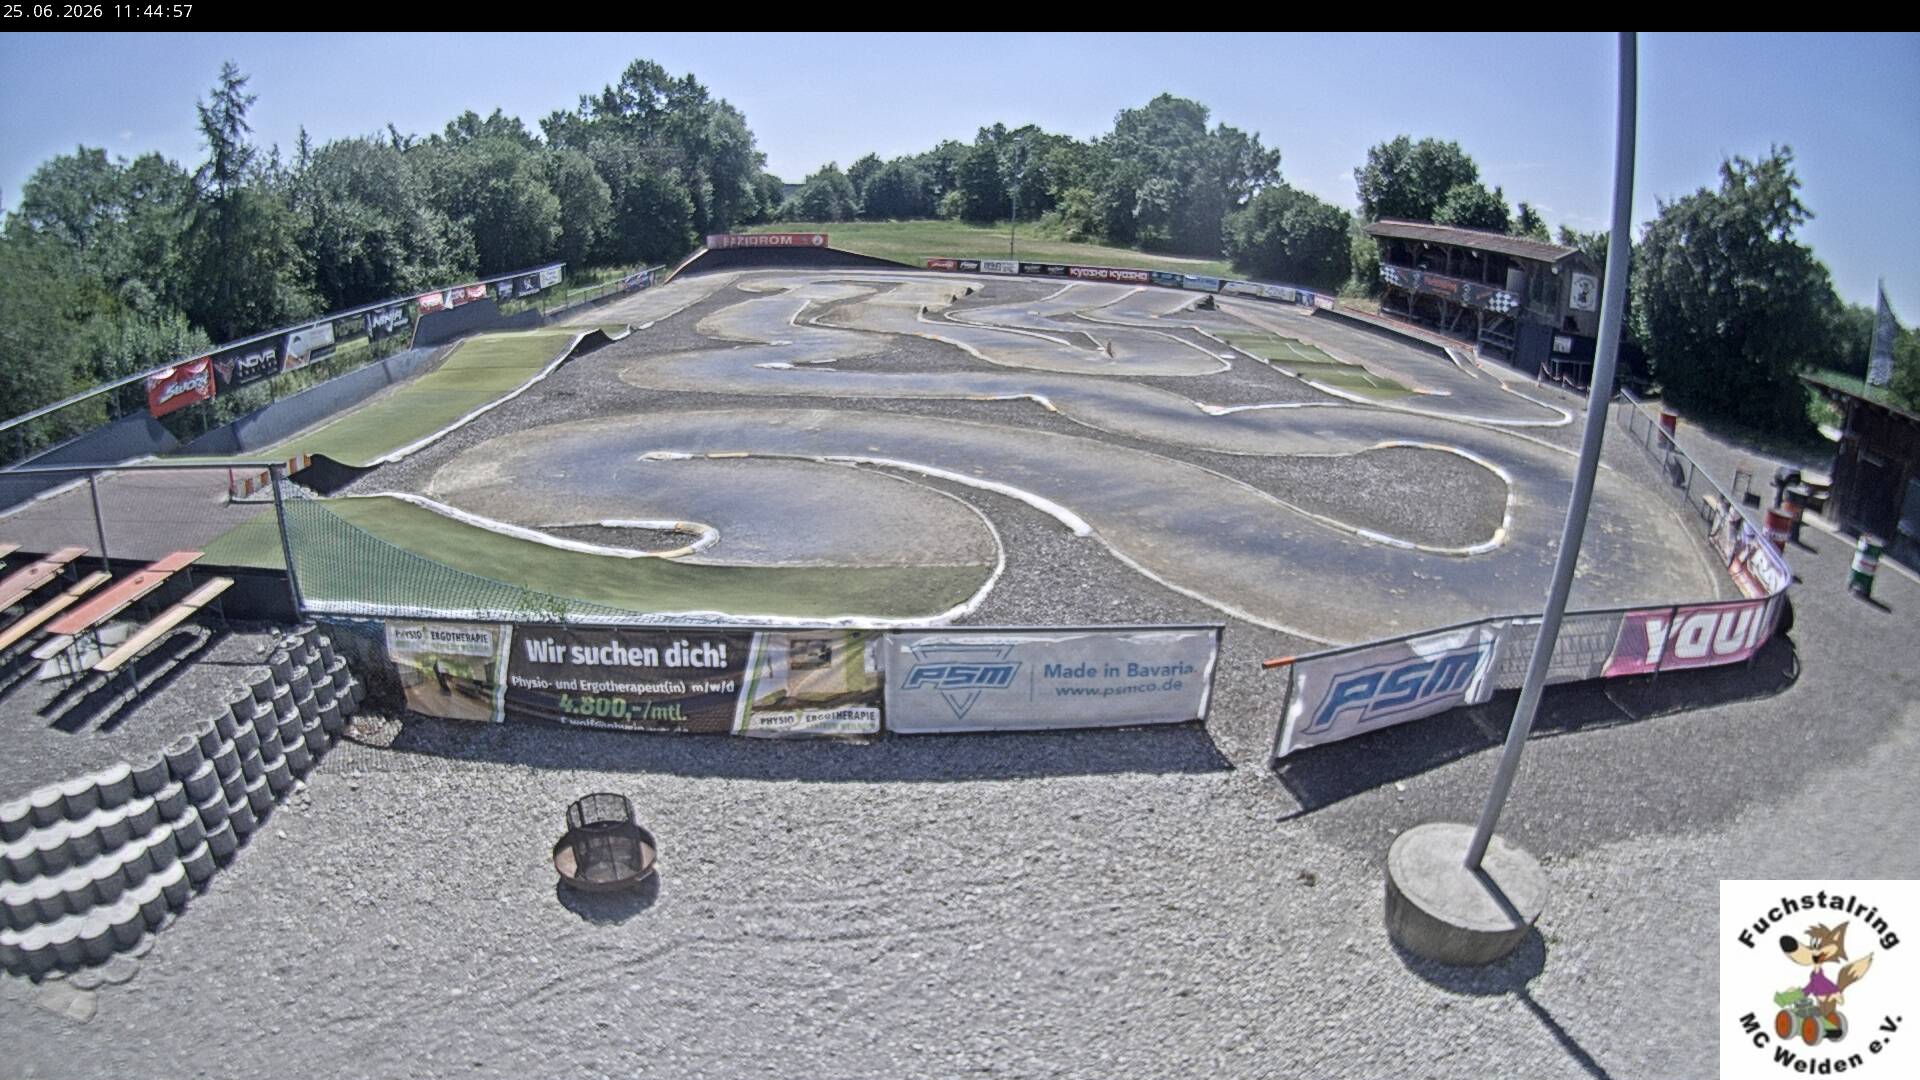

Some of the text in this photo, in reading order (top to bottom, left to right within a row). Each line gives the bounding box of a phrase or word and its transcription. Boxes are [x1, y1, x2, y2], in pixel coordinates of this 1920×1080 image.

[1069, 267, 1109, 279] KYOSHO
[1109, 269, 1148, 282] KYOSHO
[238, 348, 277, 371] NOVA
[431, 632, 489, 644] ERGOTHERAPIE
[525, 637, 728, 669] Wir suchen dich!
[902, 664, 1017, 690] PSM
[1044, 662, 1096, 680] Made
[1104, 661, 1121, 678] in
[511, 675, 736, 695] Physio- und Ergotherapeut(in) m/w/d
[1056, 677, 1184, 699] www.psmco.de
[1315, 643, 1488, 726] PSM
[760, 715, 795, 726] PHYSIO
